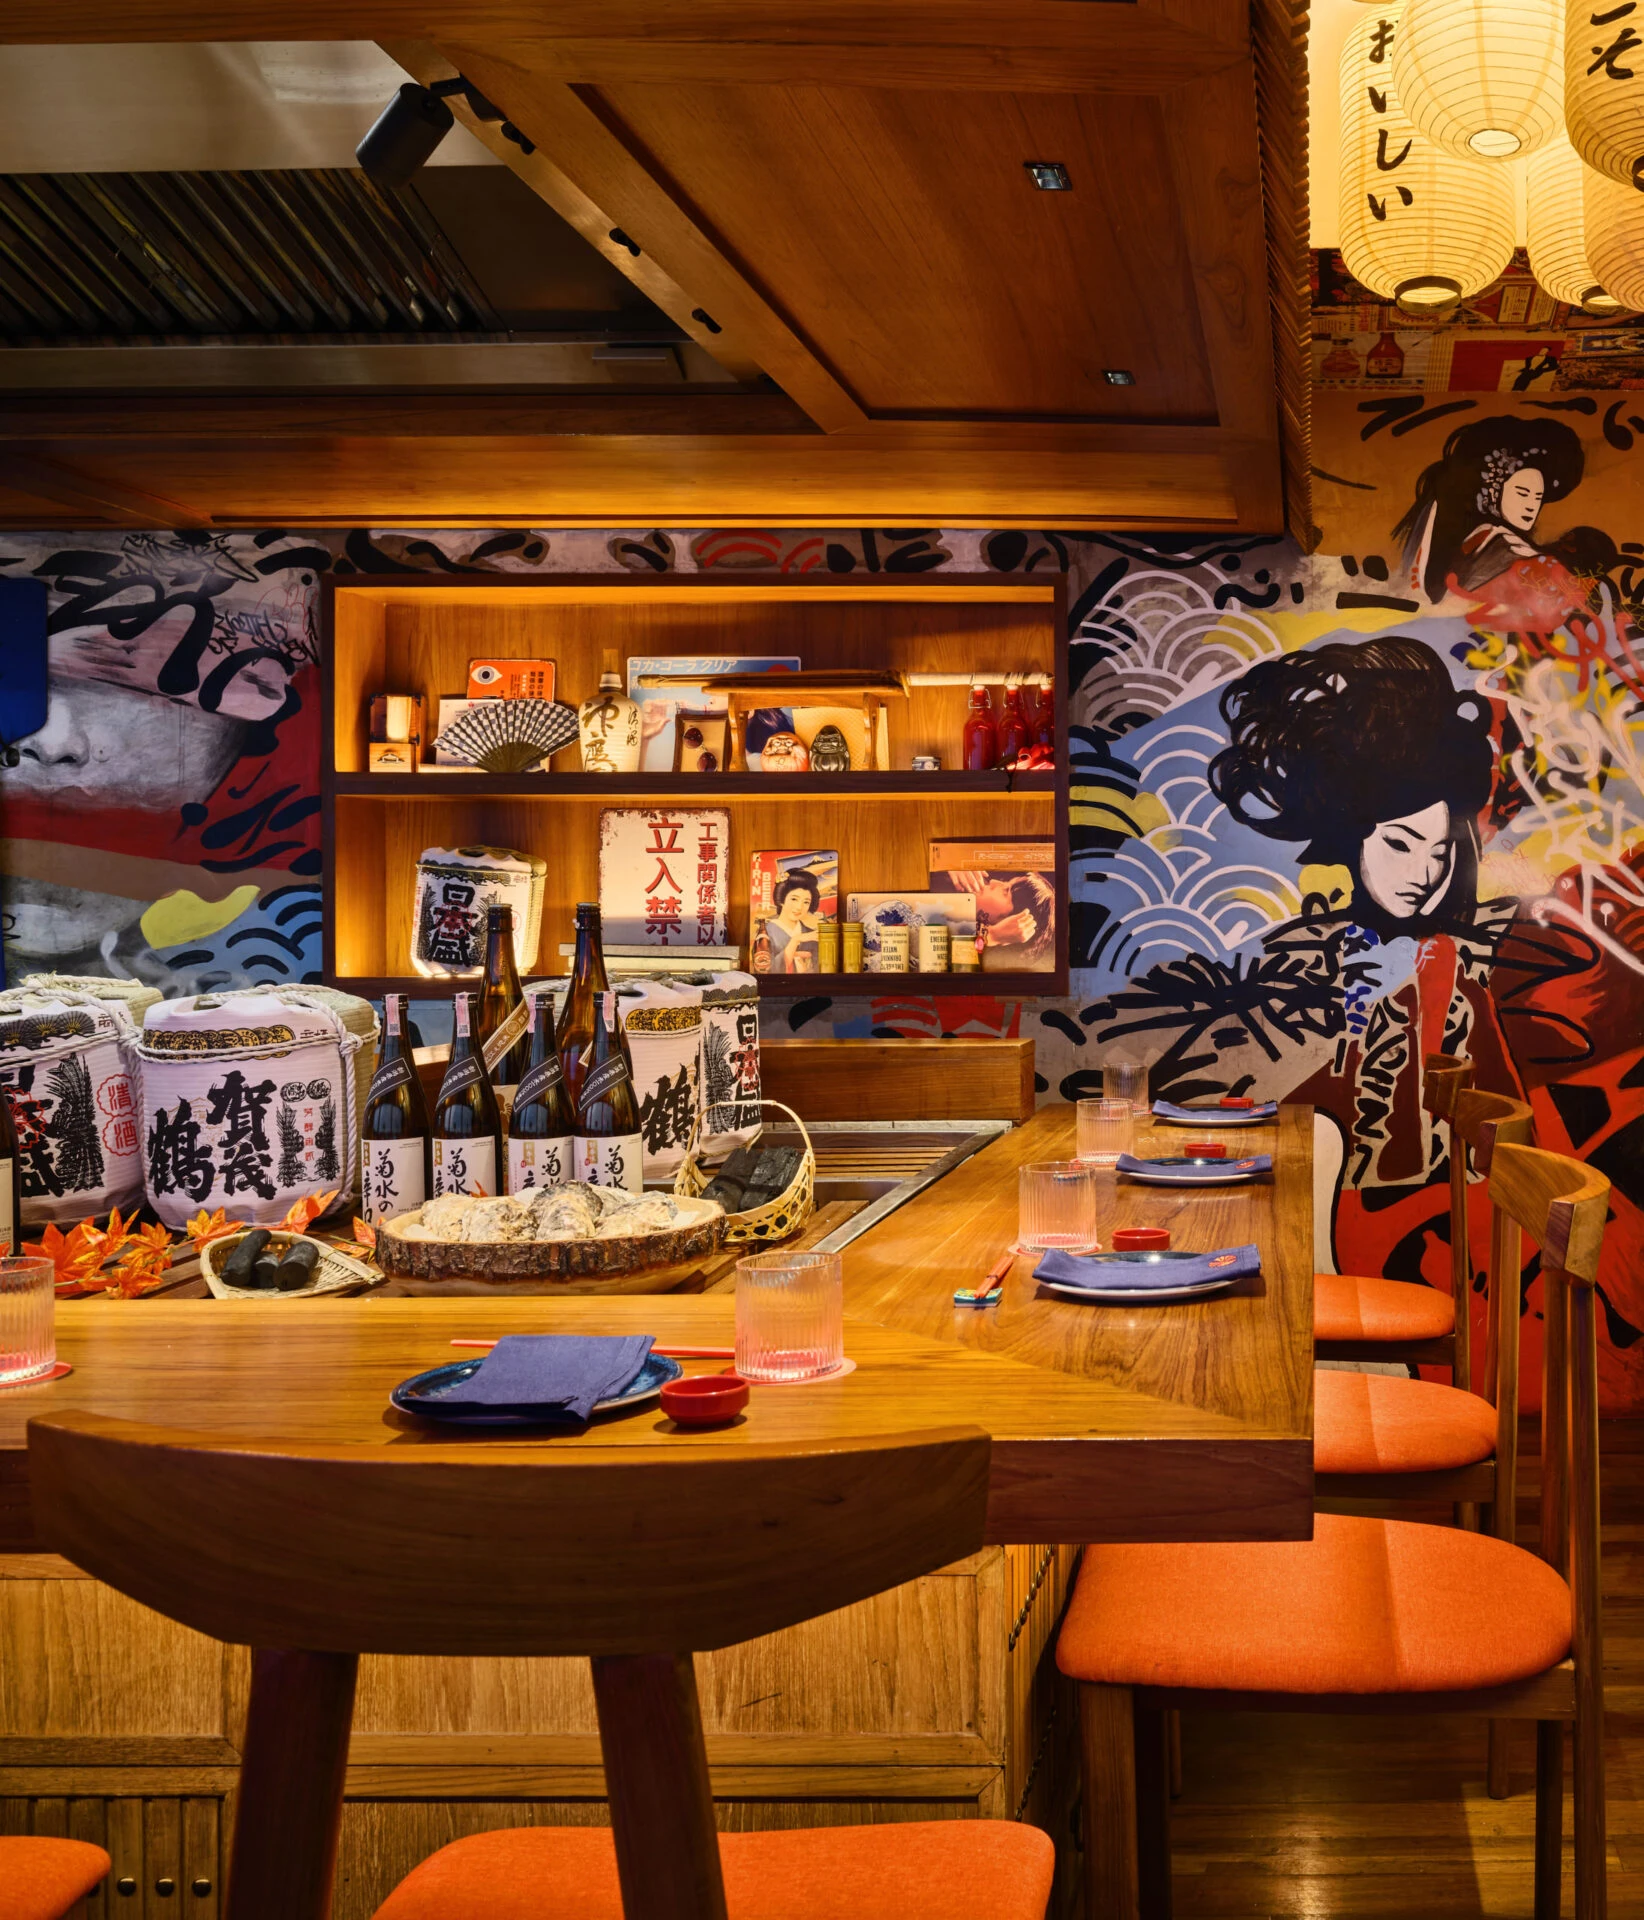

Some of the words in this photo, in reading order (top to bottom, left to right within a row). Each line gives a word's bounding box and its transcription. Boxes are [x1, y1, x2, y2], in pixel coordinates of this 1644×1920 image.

[696, 822, 719, 946] 工事関係者以
[751, 853, 762, 896] KIRIN
[761, 871, 772, 911] BEER
[374, 1147, 400, 1213] 菊水の
